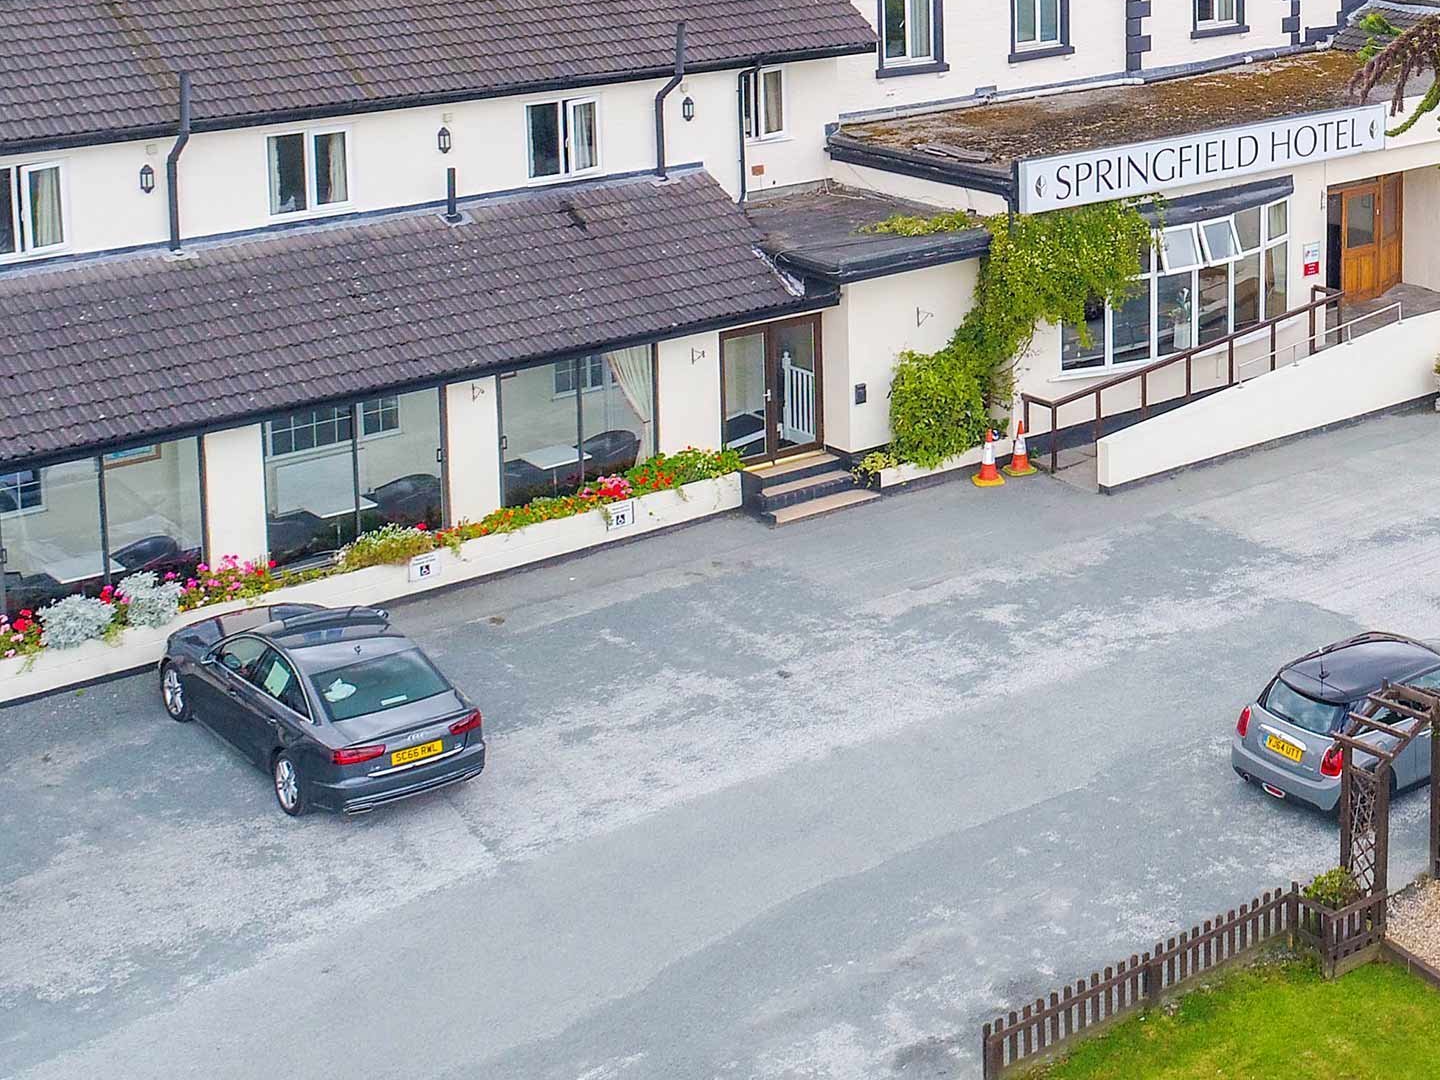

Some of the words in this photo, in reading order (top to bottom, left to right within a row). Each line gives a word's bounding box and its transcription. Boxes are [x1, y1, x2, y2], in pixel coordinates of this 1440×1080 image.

[1055, 135, 1259, 200] SPRINGFIELD
[1271, 118, 1363, 162] HOTEL
[395, 749, 420, 762] SC66
[421, 744, 438, 755] RWL
